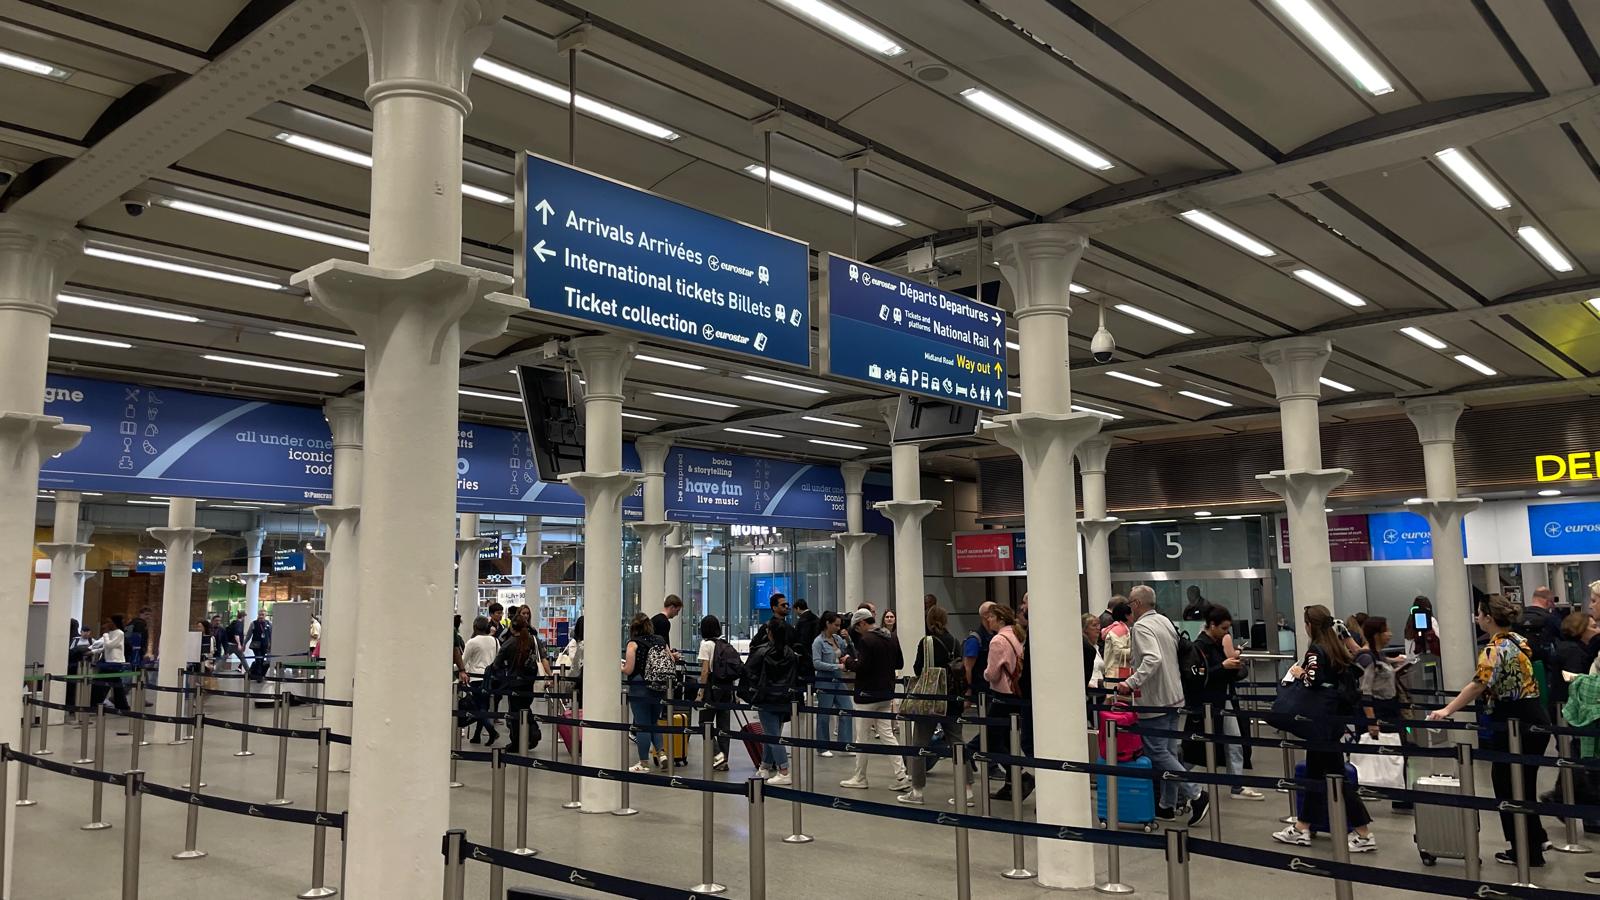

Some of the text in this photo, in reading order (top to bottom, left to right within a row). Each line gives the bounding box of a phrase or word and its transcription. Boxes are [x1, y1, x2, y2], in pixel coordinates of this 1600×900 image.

[565, 209, 755, 278] Arrivals Arrivées eurostar
[564, 247, 771, 319] International tickets Billets
[871, 278, 989, 322] eurostar Départs Departures
[564, 286, 750, 345] Ticket collection eurostar
[904, 309, 931, 324] Tickets and
[908, 320, 931, 333] platforms
[933, 320, 990, 349] National Rail
[924, 351, 955, 366] Midland Road
[956, 353, 991, 375] Way out
[235, 430, 333, 449] all under one
[288, 447, 333, 463] iconic
[712, 457, 733, 467] books
[305, 464, 332, 475] roof
[687, 465, 733, 478] & storytelling
[685, 478, 743, 496] have fun
[801, 484, 811, 492] all
[811, 485, 831, 493] under
[677, 490, 684, 502] be
[697, 495, 739, 506] live music
[824, 494, 844, 502] iconic
[1165, 532, 1183, 559] 5
